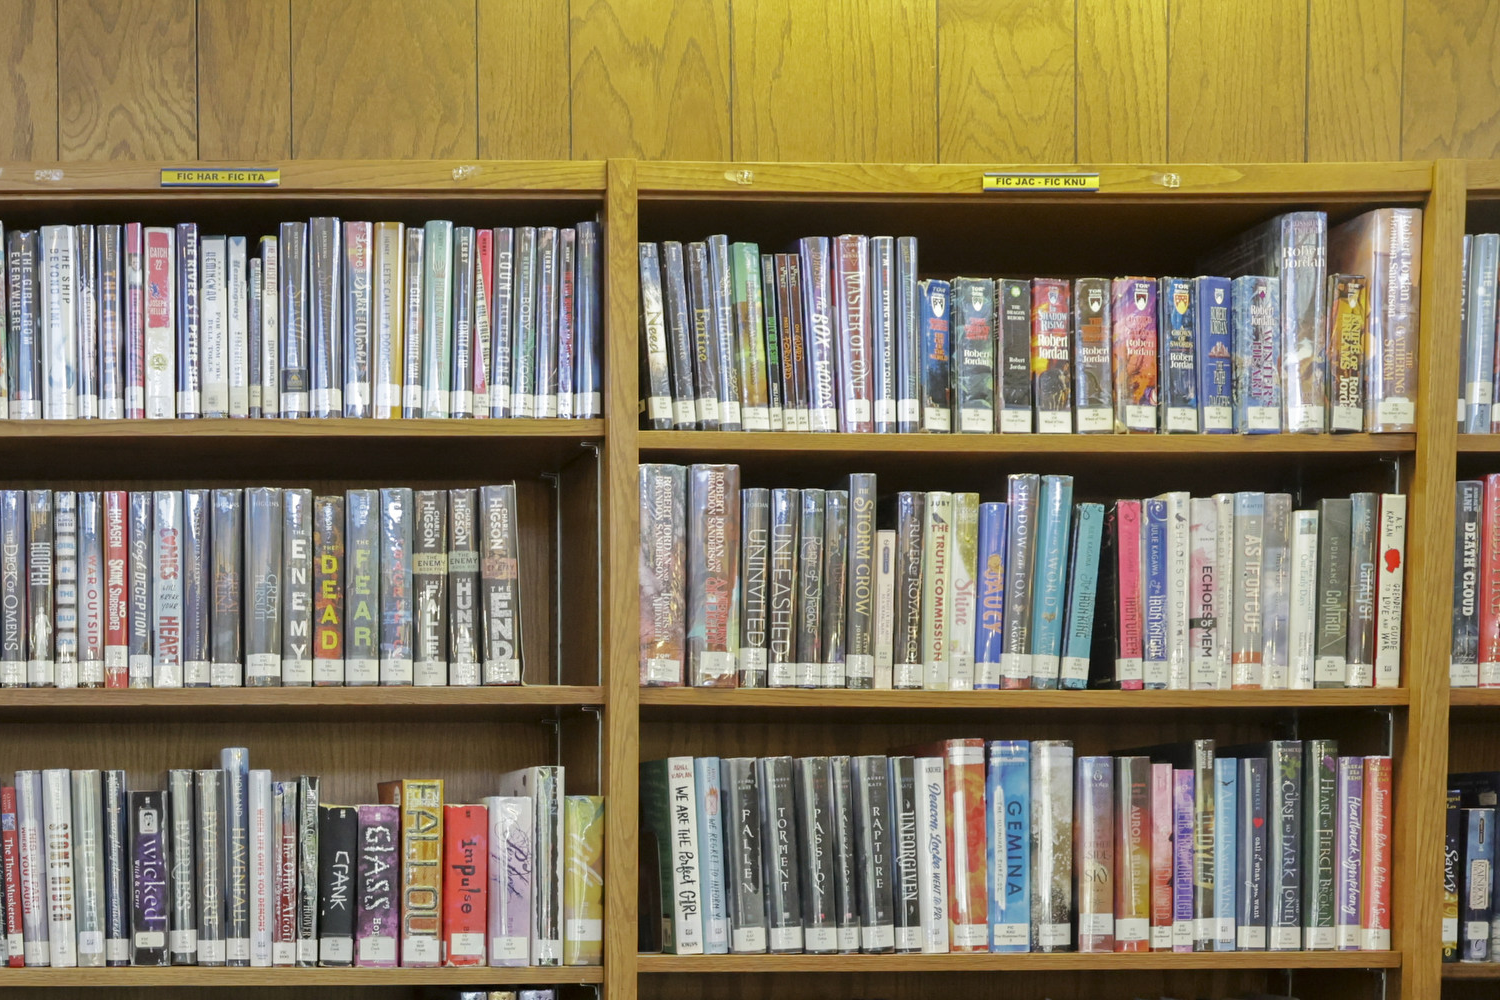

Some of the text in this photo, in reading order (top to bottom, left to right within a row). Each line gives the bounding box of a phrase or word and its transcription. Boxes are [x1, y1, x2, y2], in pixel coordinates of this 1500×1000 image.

[177, 172, 193, 181] FIC
[196, 172, 218, 181] HAR
[228, 173, 243, 181] FIC
[246, 173, 265, 181] ITA
[996, 178, 1013, 186] FIC
[1015, 178, 1036, 186] JAC
[1044, 177, 1061, 186] FIC
[1064, 177, 1086, 186] KNU
[150, 247, 167, 258] CATCH
[1038, 334, 1069, 360] Robert Jordan
[355, 550, 371, 647] FEAR
[772, 523, 791, 655] UNLEASHED
[933, 535, 944, 660] TRUTH COMMISSION
[143, 840, 165, 921] Wicked
[742, 809, 754, 893] FALLEN
[777, 807, 789, 892] TORMENT
[872, 807, 883, 889] RAPTURE
[1007, 801, 1022, 896] GEMINA
